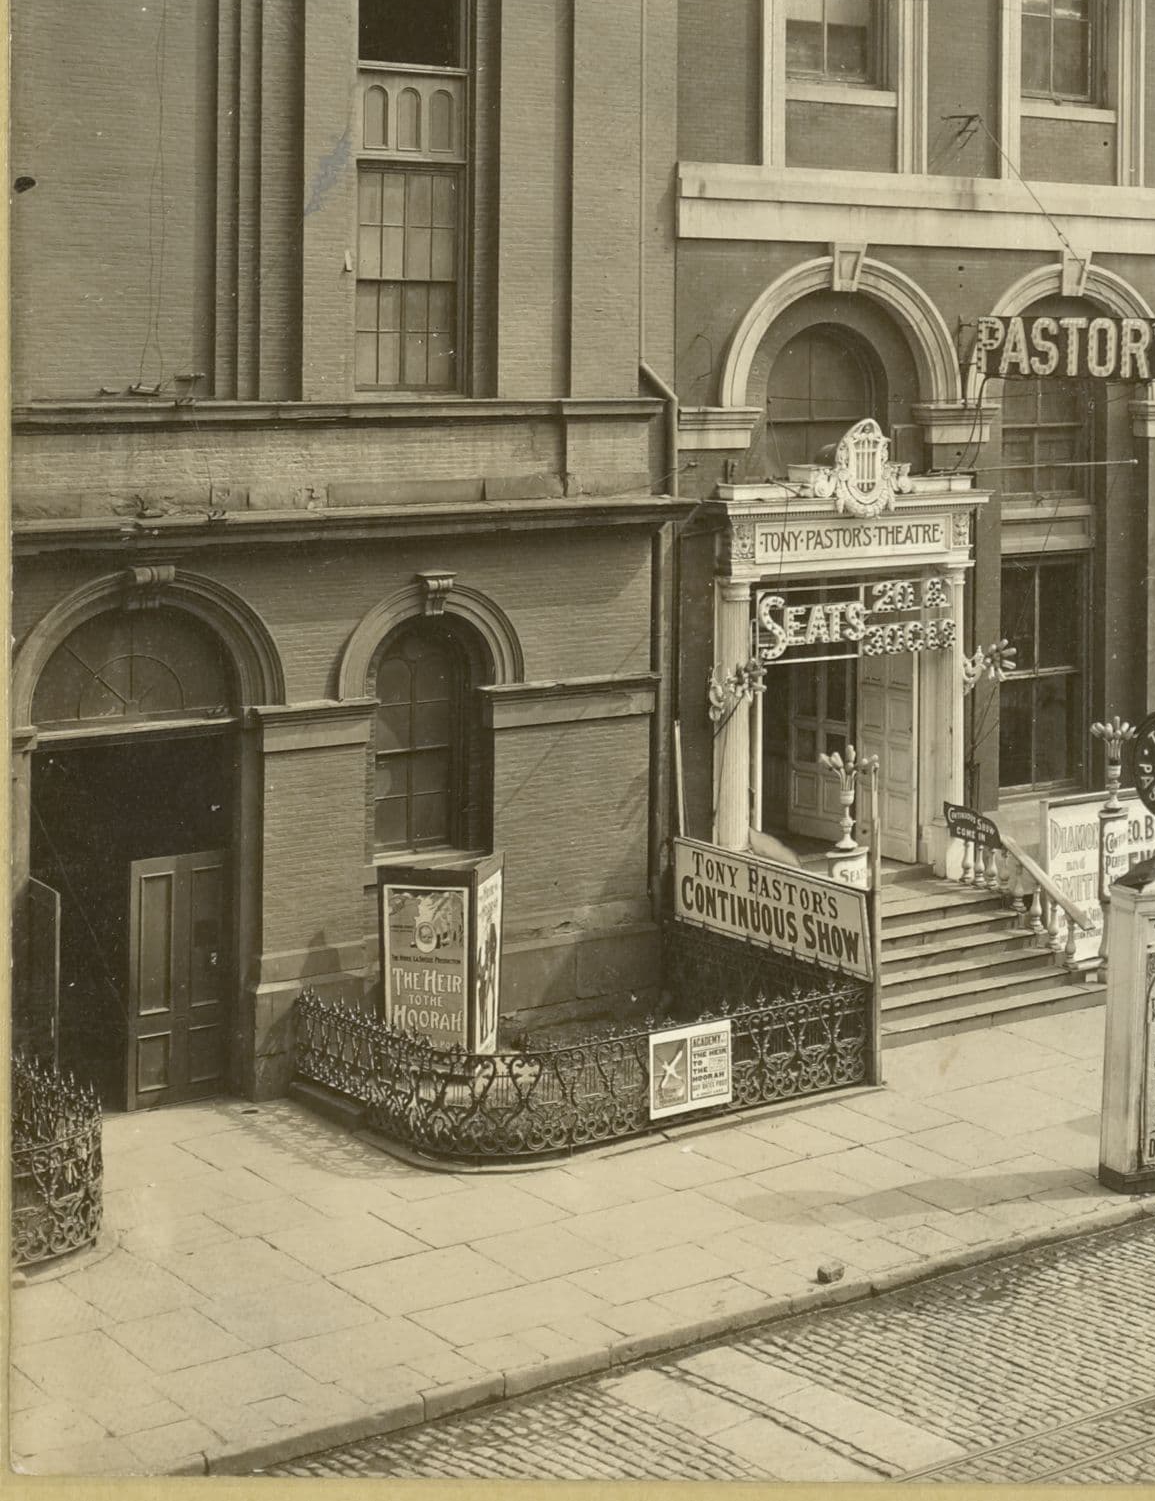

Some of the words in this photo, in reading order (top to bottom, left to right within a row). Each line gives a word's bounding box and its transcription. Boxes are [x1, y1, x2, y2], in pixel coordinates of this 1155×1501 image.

[760, 531, 801, 552] TONY
[806, 525, 872, 550] PASTOR'S
[874, 523, 941, 547] THEATRE
[872, 580, 915, 613] 20
[759, 596, 866, 660] SEATS
[956, 826, 976, 839] COME
[692, 850, 739, 889] TONY
[747, 865, 839, 920] PASTOR'S
[681, 875, 799, 944] CONTINUOUS
[802, 913, 860, 965] SHOW
[392, 967, 420, 996] THE
[422, 969, 463, 995] HEIR
[408, 994, 421, 1006] TO
[423, 995, 443, 1008] THE
[393, 1004, 464, 1032] HOORAH
[693, 1067, 708, 1075] THE
